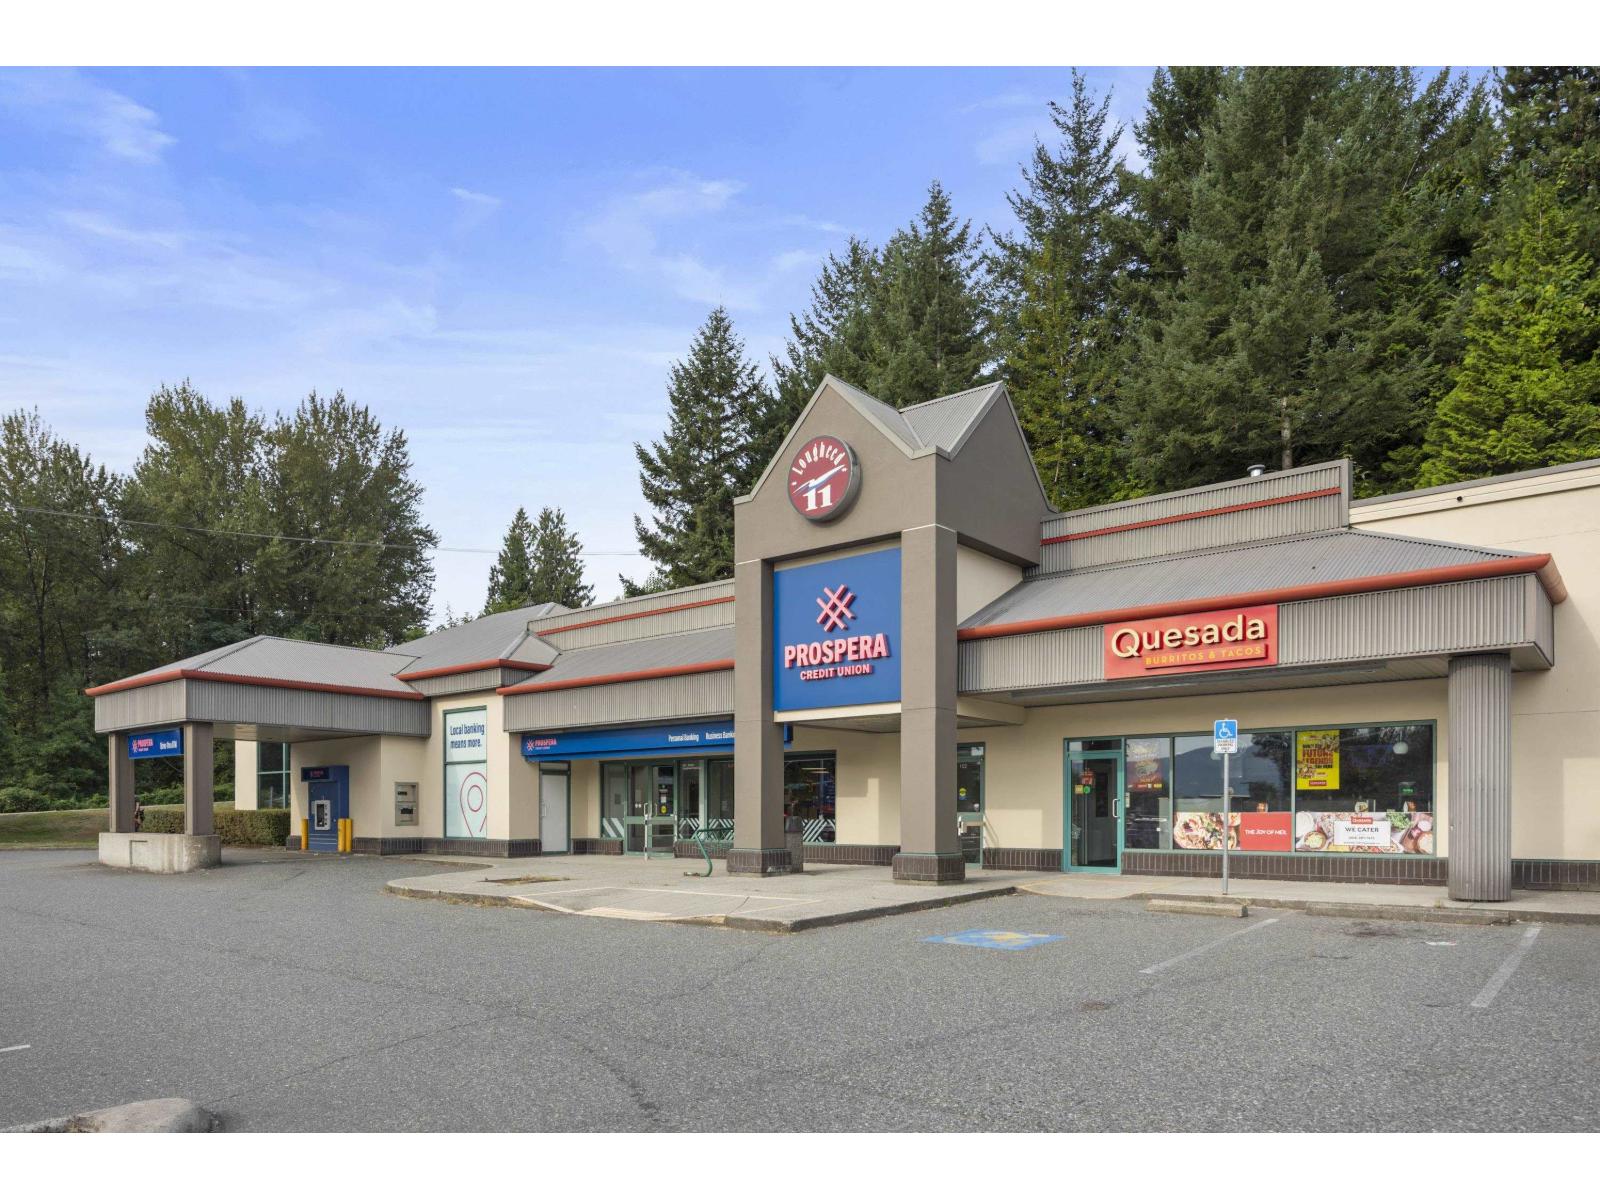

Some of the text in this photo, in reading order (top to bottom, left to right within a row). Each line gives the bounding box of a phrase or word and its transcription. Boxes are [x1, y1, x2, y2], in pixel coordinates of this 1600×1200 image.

[792, 441, 846, 475] Lougheed
[803, 484, 833, 511] 11
[1111, 614, 1266, 658] Quesada
[784, 633, 889, 669] PROSPERA
[1145, 646, 1263, 666] BURRITOS & TACOS
[800, 663, 871, 681] CREDIT UNION
[450, 723, 485, 736] Local banking
[450, 740, 467, 749] means
